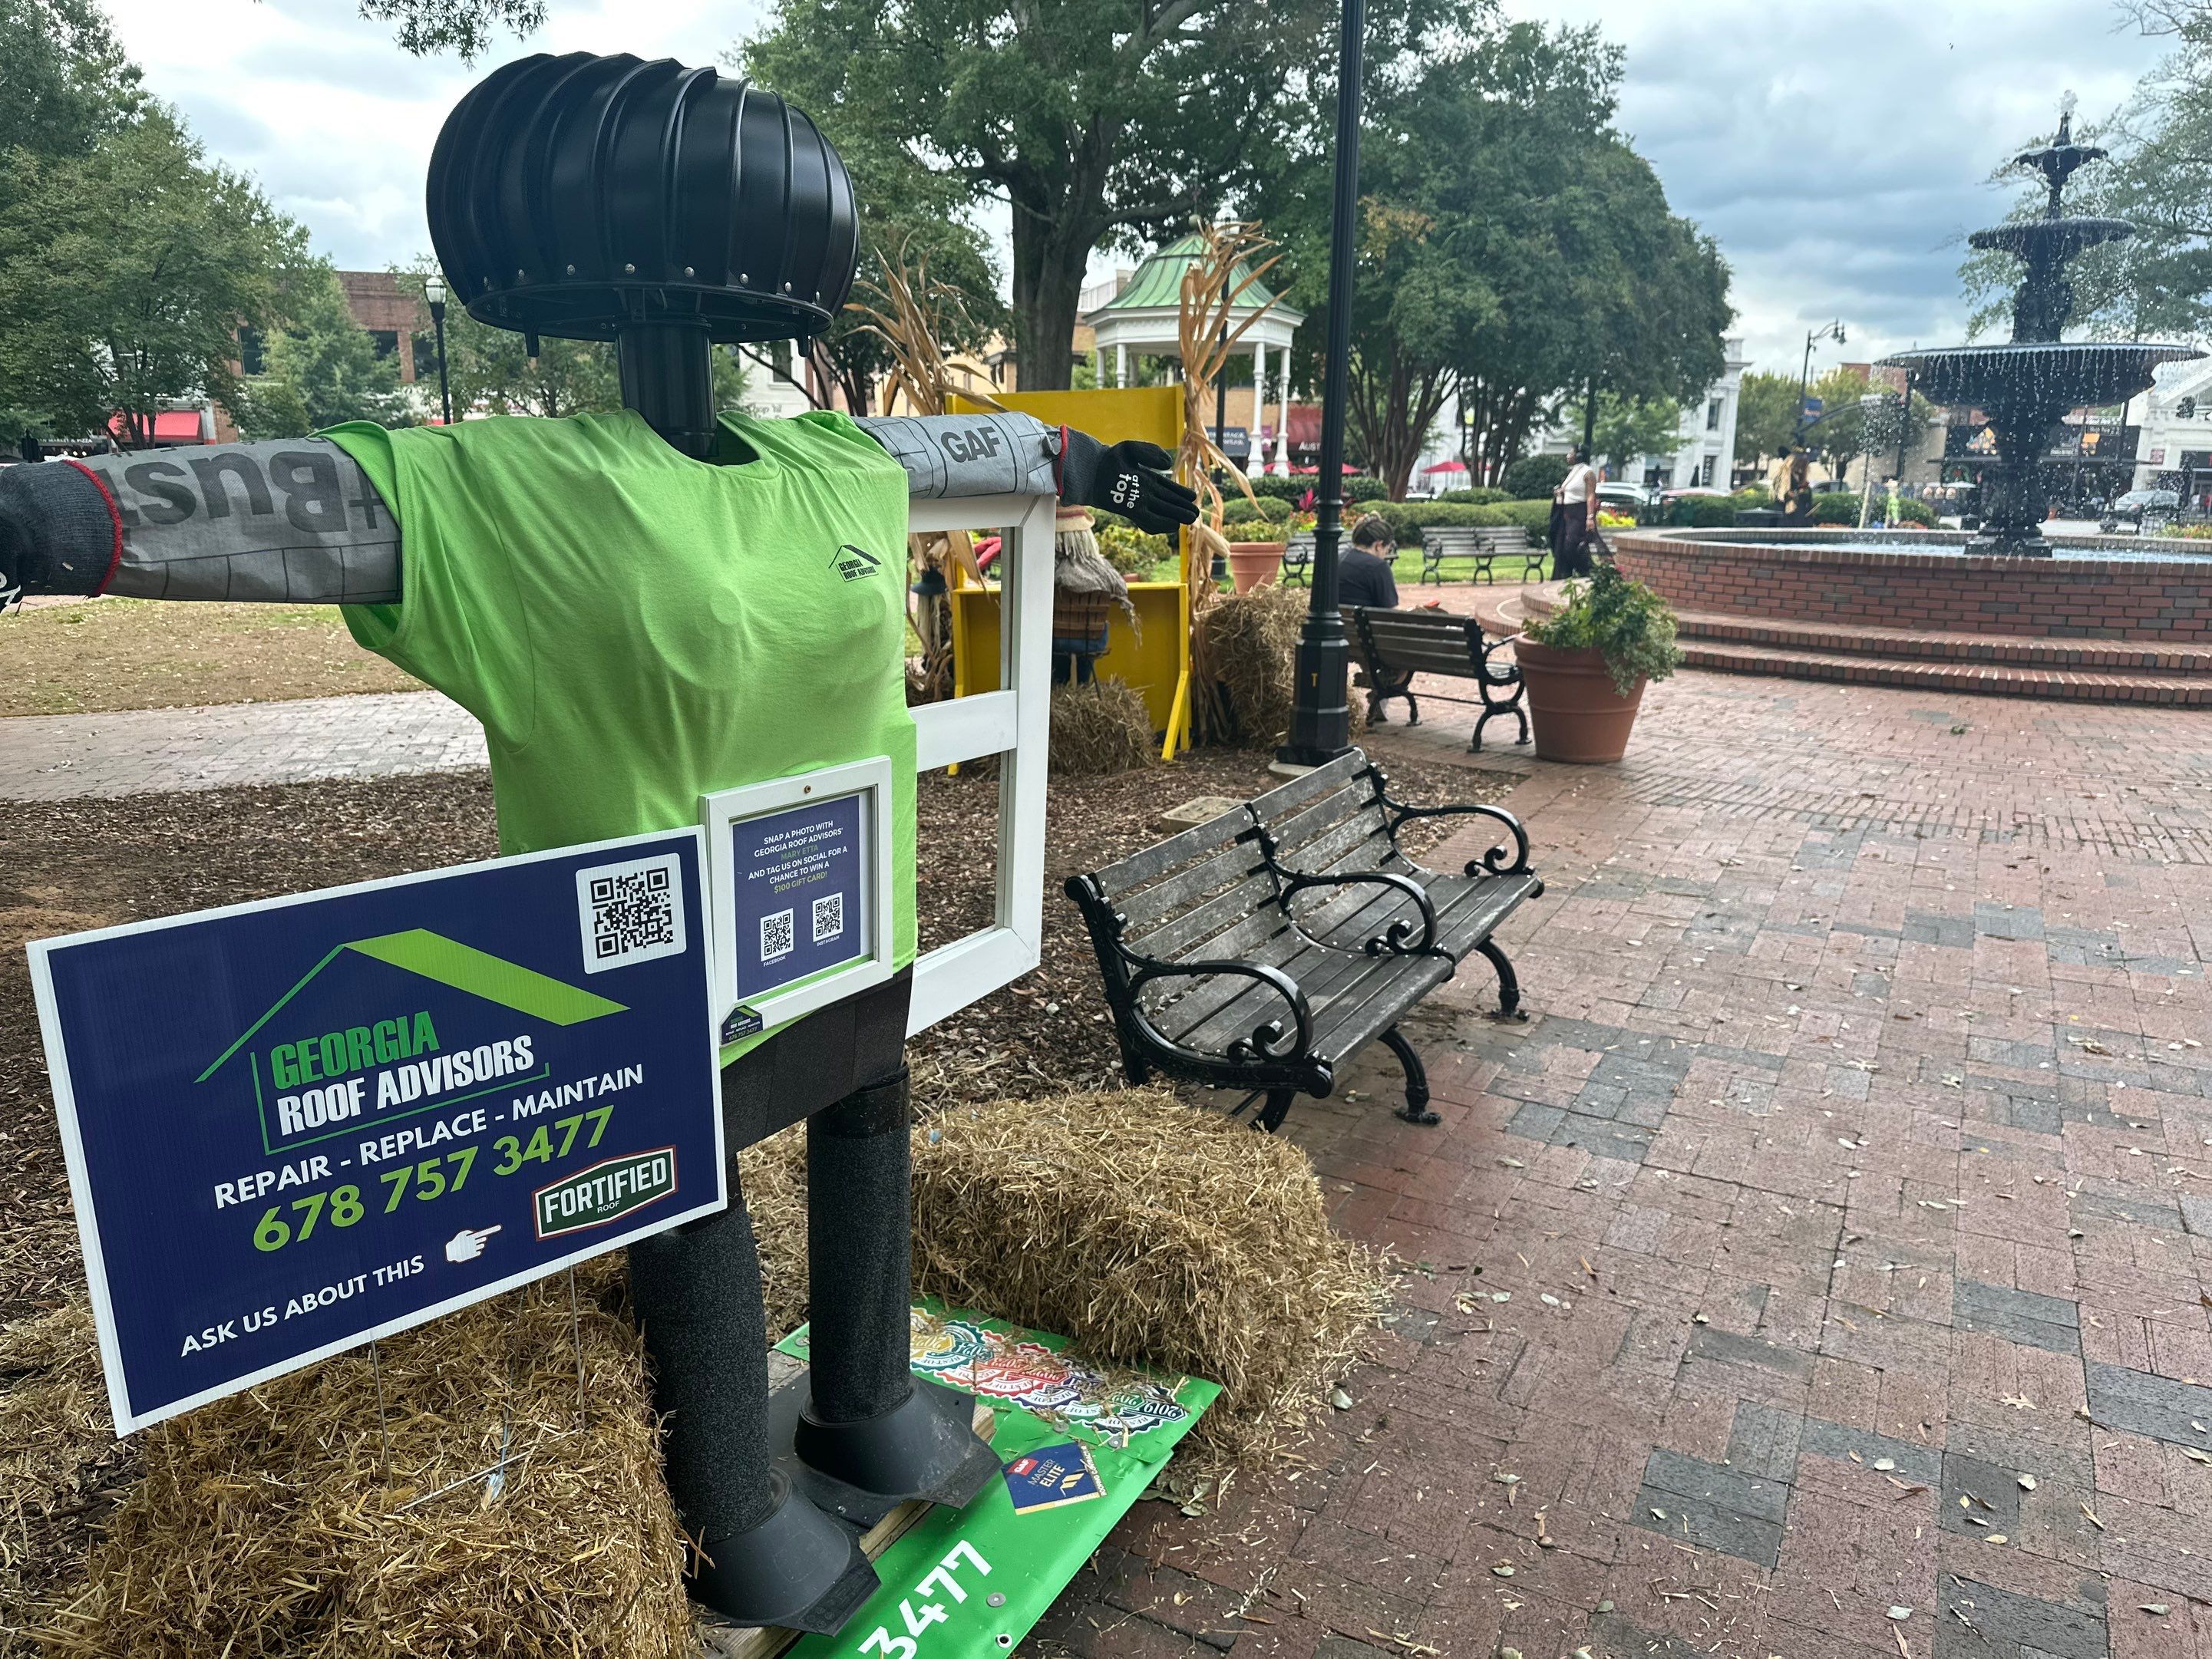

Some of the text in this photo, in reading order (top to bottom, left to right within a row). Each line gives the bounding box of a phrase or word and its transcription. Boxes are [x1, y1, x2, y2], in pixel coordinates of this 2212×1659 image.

[940, 426, 1001, 463] GAF
[1110, 473, 1132, 504] top
[1126, 474, 1140, 509] at the
[838, 559, 863, 572] GEORGIA
[843, 569, 857, 580] ROOF
[754, 827, 844, 858] GEORGIA ROOF ADVISORS'
[764, 820, 834, 845] SNAP A PHOTO WITH
[748, 869, 765, 881] AND
[766, 865, 781, 875] TAG
[781, 862, 791, 870] US
[792, 859, 803, 868] ON
[803, 852, 827, 865] SOCIAL
[828, 848, 841, 858] FOR
[781, 844, 819, 860] MARY ETTA
[769, 869, 799, 885] CHANCE
[799, 866, 809, 875] TO
[809, 862, 824, 872] WIN
[774, 871, 827, 894] $100 GIFT CARD!
[816, 935, 840, 947] INSTAGRAM
[763, 955, 787, 968] FACEBOOK
[270, 1011, 440, 1090] GEORGIA
[277, 1034, 535, 1136] ROOF ADVISORS
[214, 1155, 332, 1209] REPAIR
[339, 1159, 352, 1167] -
[359, 1108, 487, 1165] REPLACE
[512, 1064, 644, 1121] MAINTAIN
[253, 1104, 615, 1252] 678 757 3477
[544, 1157, 667, 1224] FORTIFIED
[597, 1199, 620, 1214] ROOF
[180, 1255, 425, 1357] ASK US ABOUT THIS
[1144, 1400, 1179, 1418] 2019
[1027, 1459, 1058, 1486] MASTER
[1039, 1463, 1065, 1487] ELITE
[857, 1539, 993, 1659] 3477
